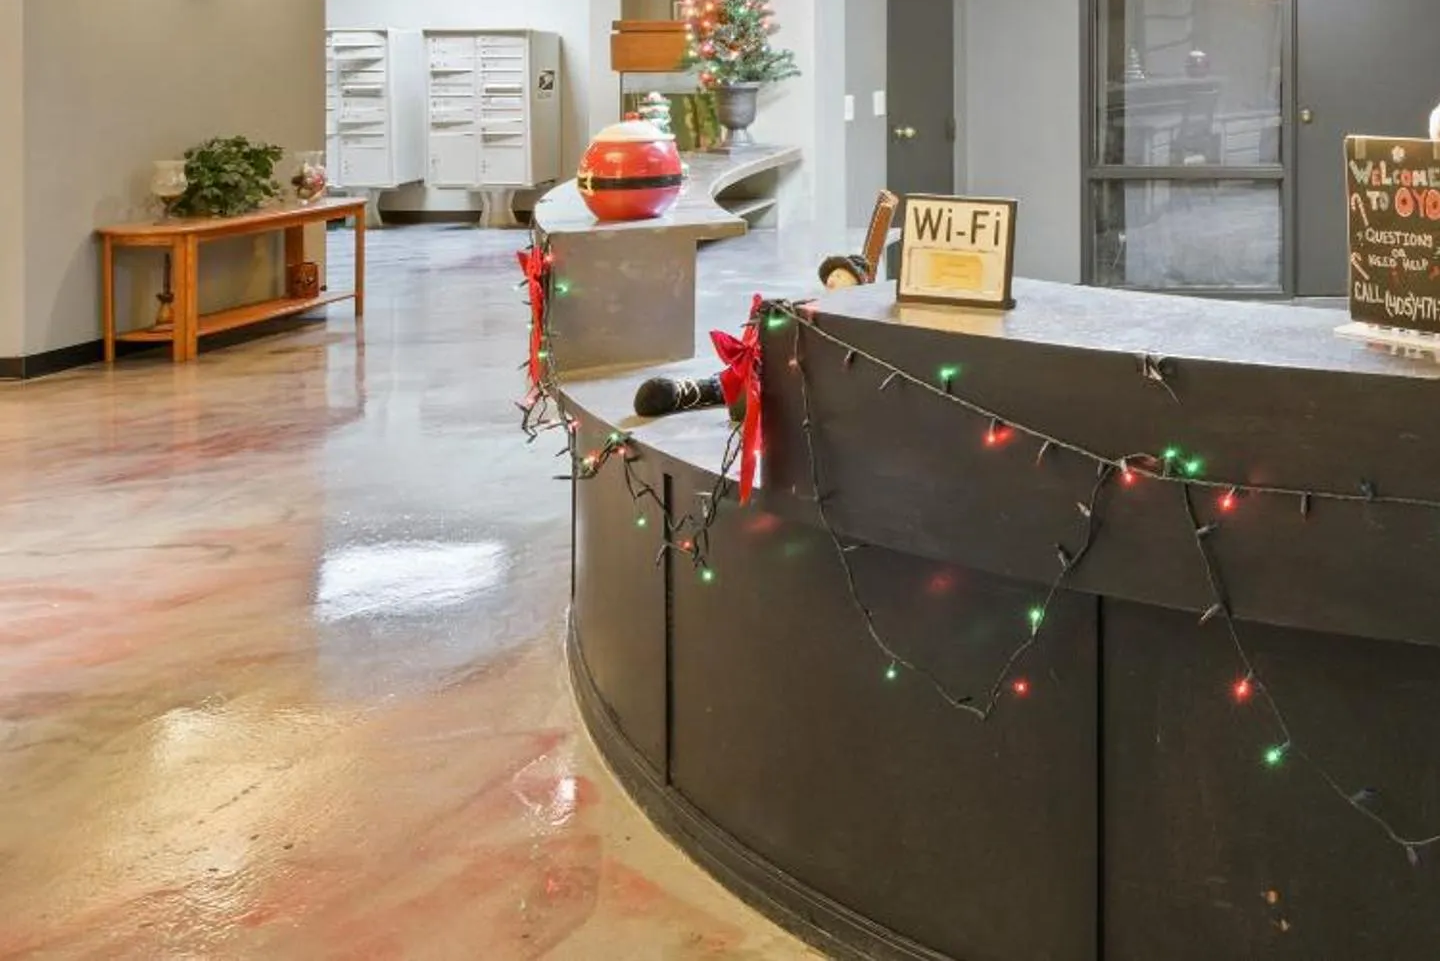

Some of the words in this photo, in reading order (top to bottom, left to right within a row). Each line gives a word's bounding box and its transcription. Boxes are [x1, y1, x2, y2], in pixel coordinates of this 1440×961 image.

[1366, 190, 1389, 211] TO
[913, 206, 1001, 247] Wi-Fi
[1365, 227, 1433, 248] QUESTIONS
[1354, 281, 1384, 304] CALL
